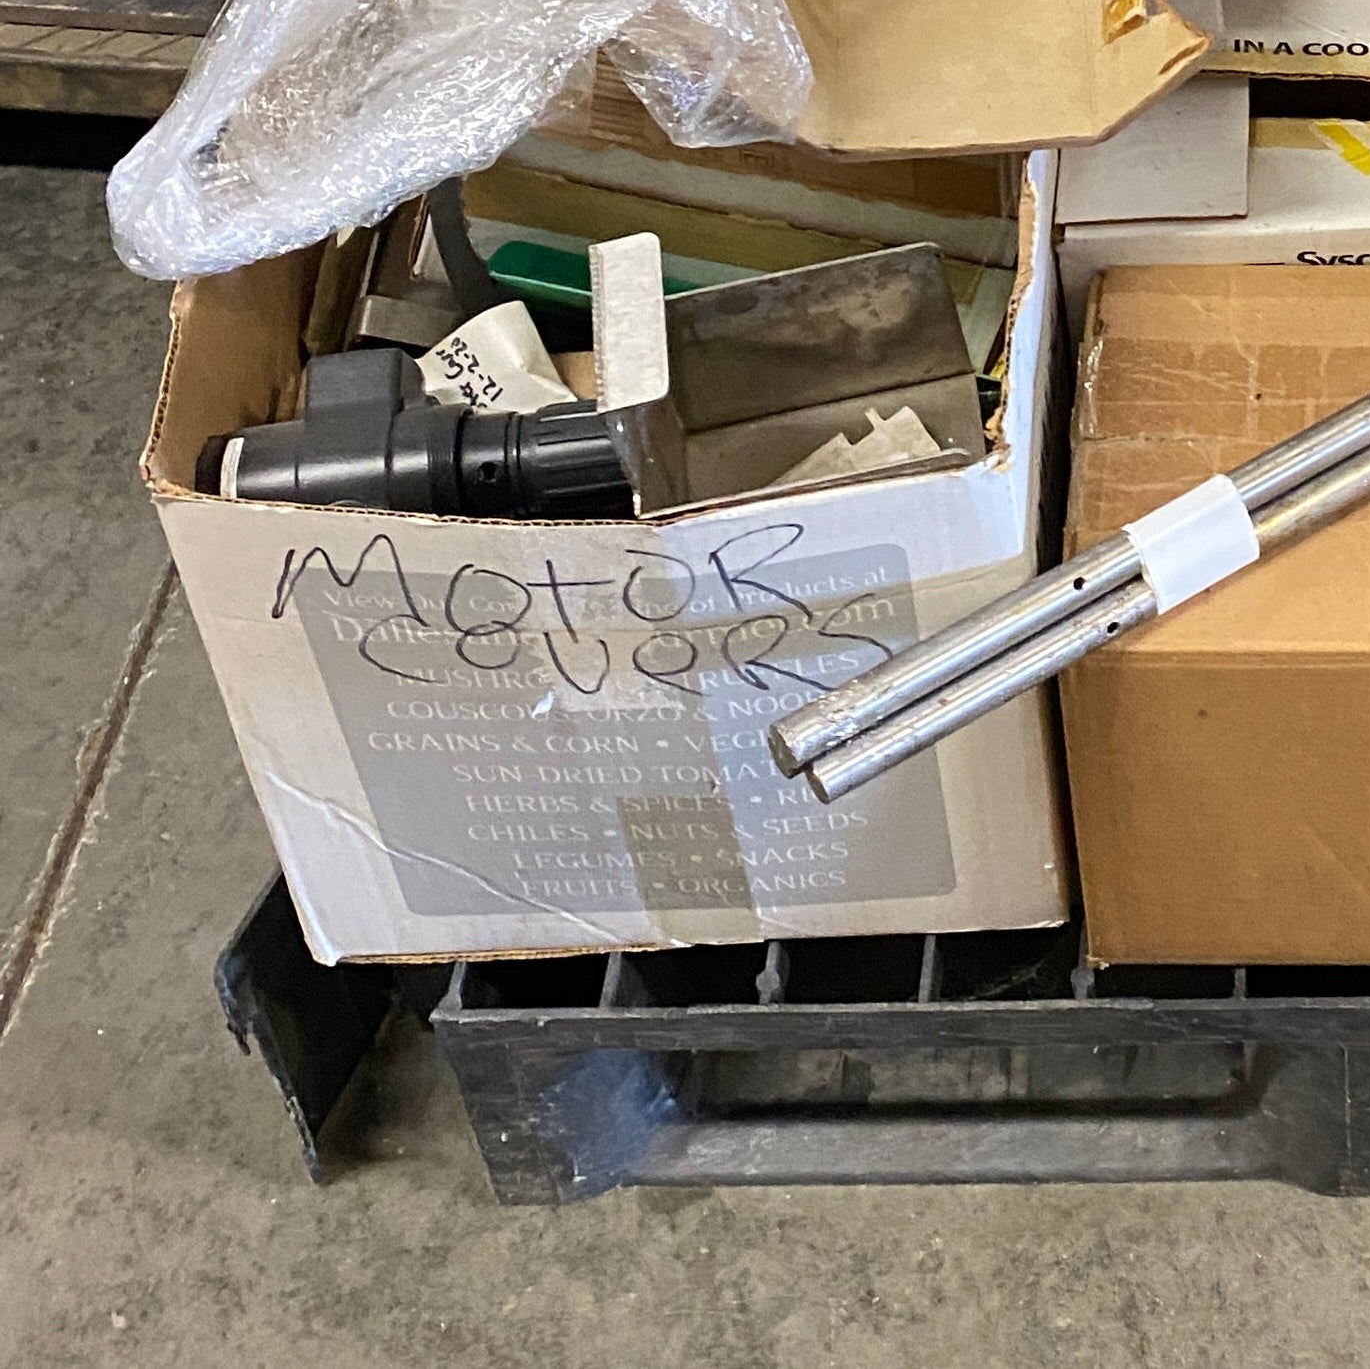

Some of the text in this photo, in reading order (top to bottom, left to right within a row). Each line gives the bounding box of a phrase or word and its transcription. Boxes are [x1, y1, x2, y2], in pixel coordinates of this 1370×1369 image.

[1233, 38, 1265, 53] IN
[1273, 41, 1295, 56] A
[367, 732, 640, 754] GRAINS & CORN
[464, 794, 580, 813] HERBS
[588, 796, 613, 813] &
[467, 825, 591, 842] CHILES
[762, 810, 869, 836] SEEDS
[513, 840, 849, 870] LEGUMES SNACKS
[519, 879, 638, 897] FRUITS
